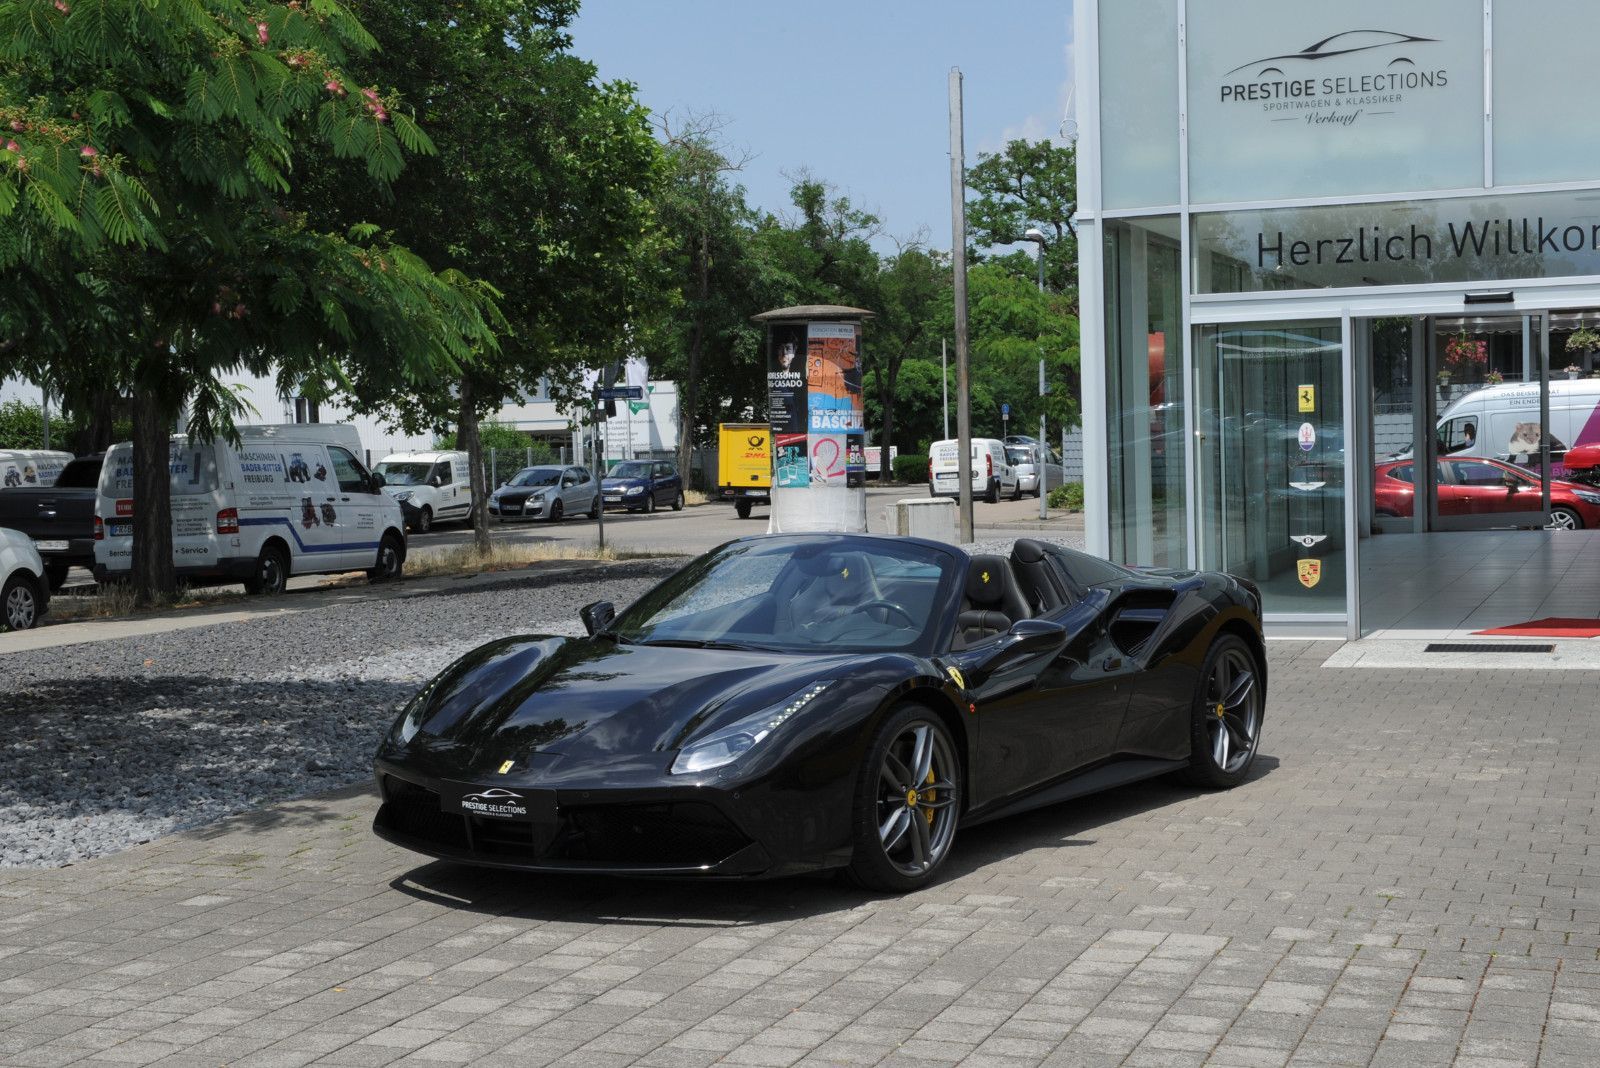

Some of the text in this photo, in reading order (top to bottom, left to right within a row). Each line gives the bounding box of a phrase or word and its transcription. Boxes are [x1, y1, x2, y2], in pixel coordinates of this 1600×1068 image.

[1221, 70, 1448, 102] PRESTIGE SELECTIONS
[1262, 94, 1402, 111] SPORTWAGEN & KLASSIKER
[1304, 109, 1363, 126] Verkauf
[1258, 224, 1432, 268] Herzlich
[238, 453, 276, 463] MASCHINEN
[241, 463, 283, 474] BADER-RITTER
[244, 474, 274, 484] FREIBURG
[180, 547, 208, 555] Service
[461, 800, 527, 815] PRESTIGE SELECTIONS
